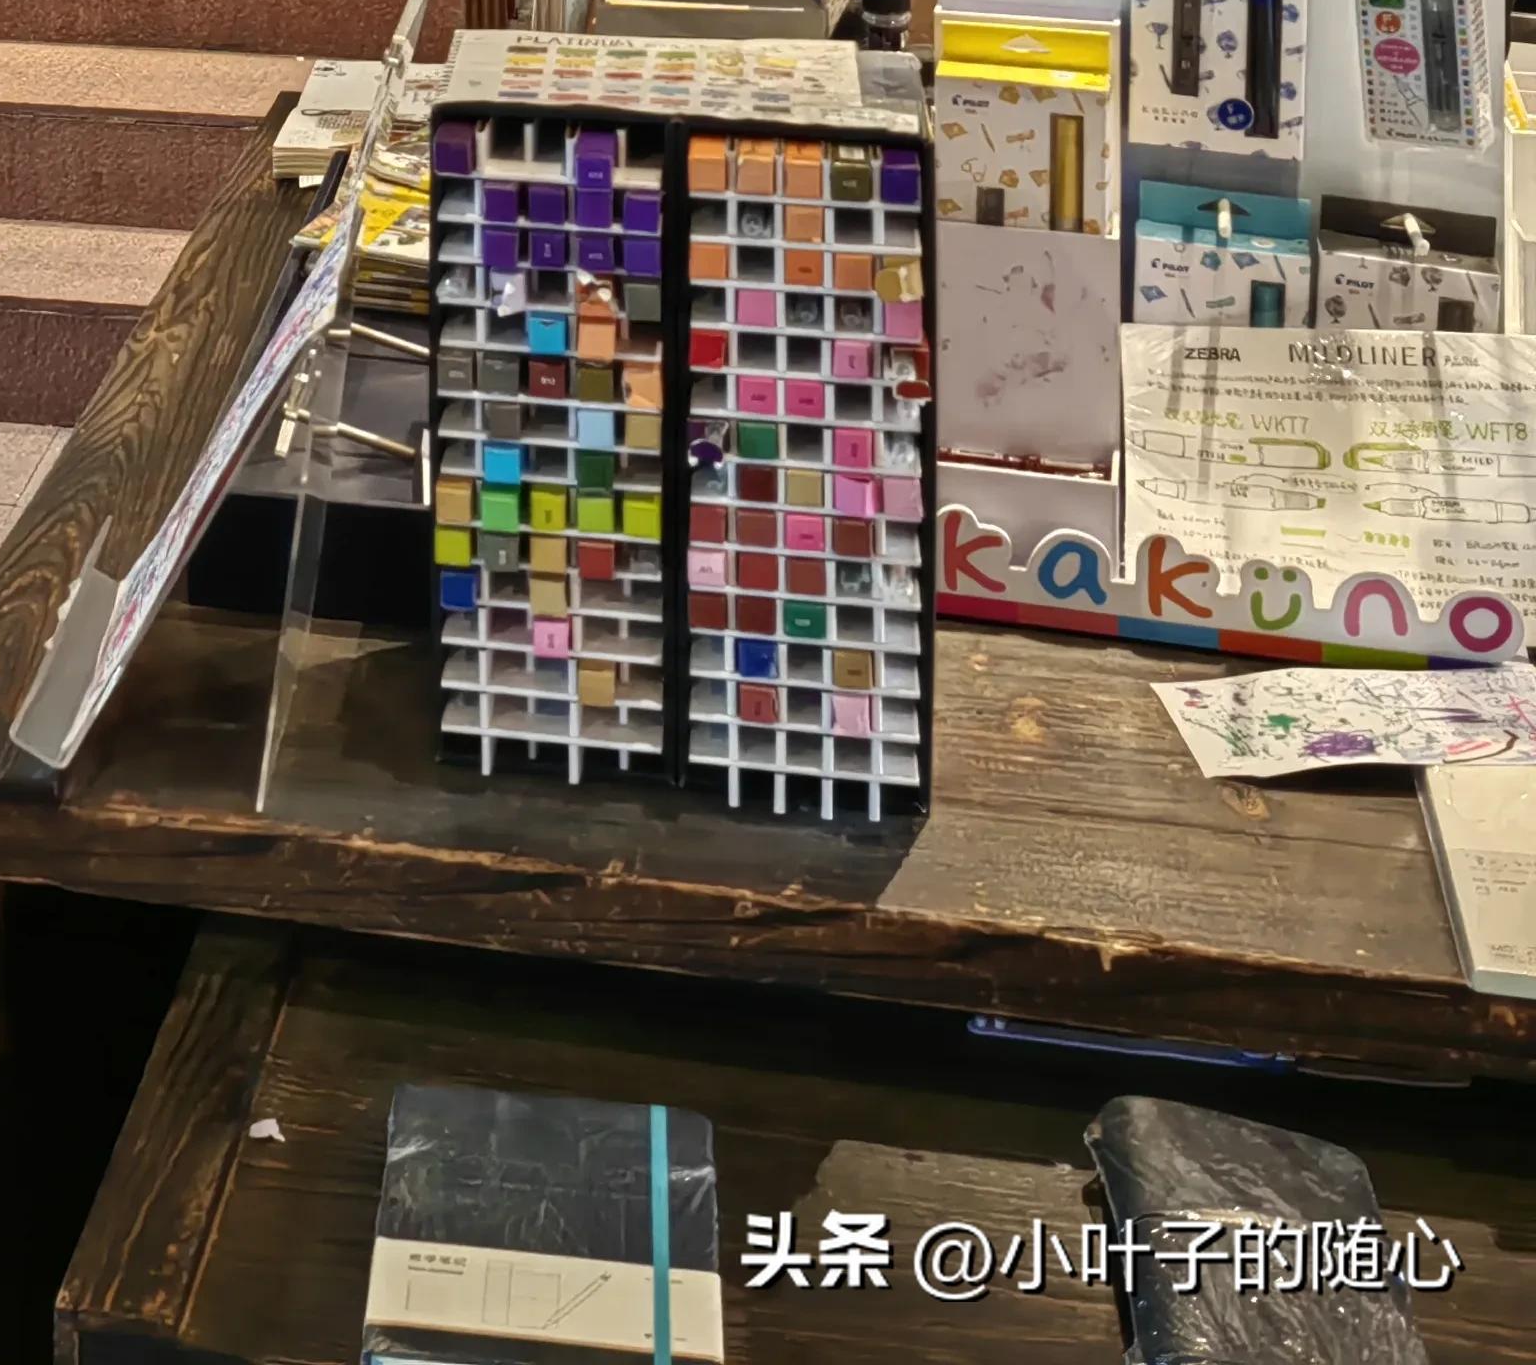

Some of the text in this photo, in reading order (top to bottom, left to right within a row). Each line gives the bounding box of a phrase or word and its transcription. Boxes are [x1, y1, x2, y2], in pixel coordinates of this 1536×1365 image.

[1183, 342, 1438, 368] ZEBRA MILDLINER
[1464, 421, 1529, 442] WFT8
